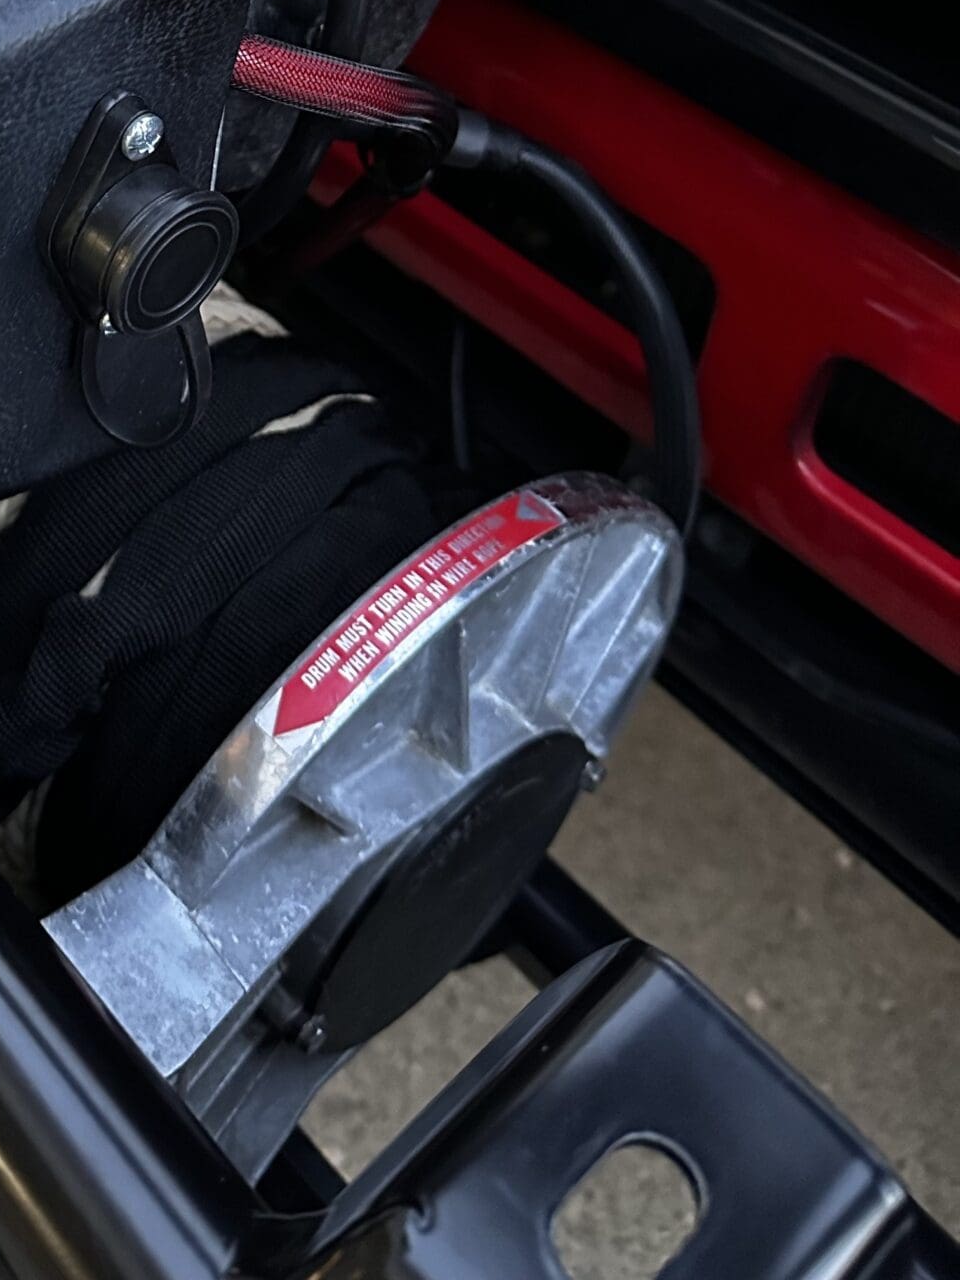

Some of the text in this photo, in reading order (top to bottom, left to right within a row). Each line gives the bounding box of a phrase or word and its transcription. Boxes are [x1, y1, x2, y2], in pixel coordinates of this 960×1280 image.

[300, 648, 341, 689] DRUM
[336, 614, 374, 654] MUST
[368, 586, 407, 619] TURN
[402, 571, 424, 590] IN
[418, 549, 451, 577] THIS
[338, 641, 380, 682] WHEN
[374, 591, 433, 644] WINDING
[427, 579, 448, 600] IN
[442, 558, 476, 587] WIRE
